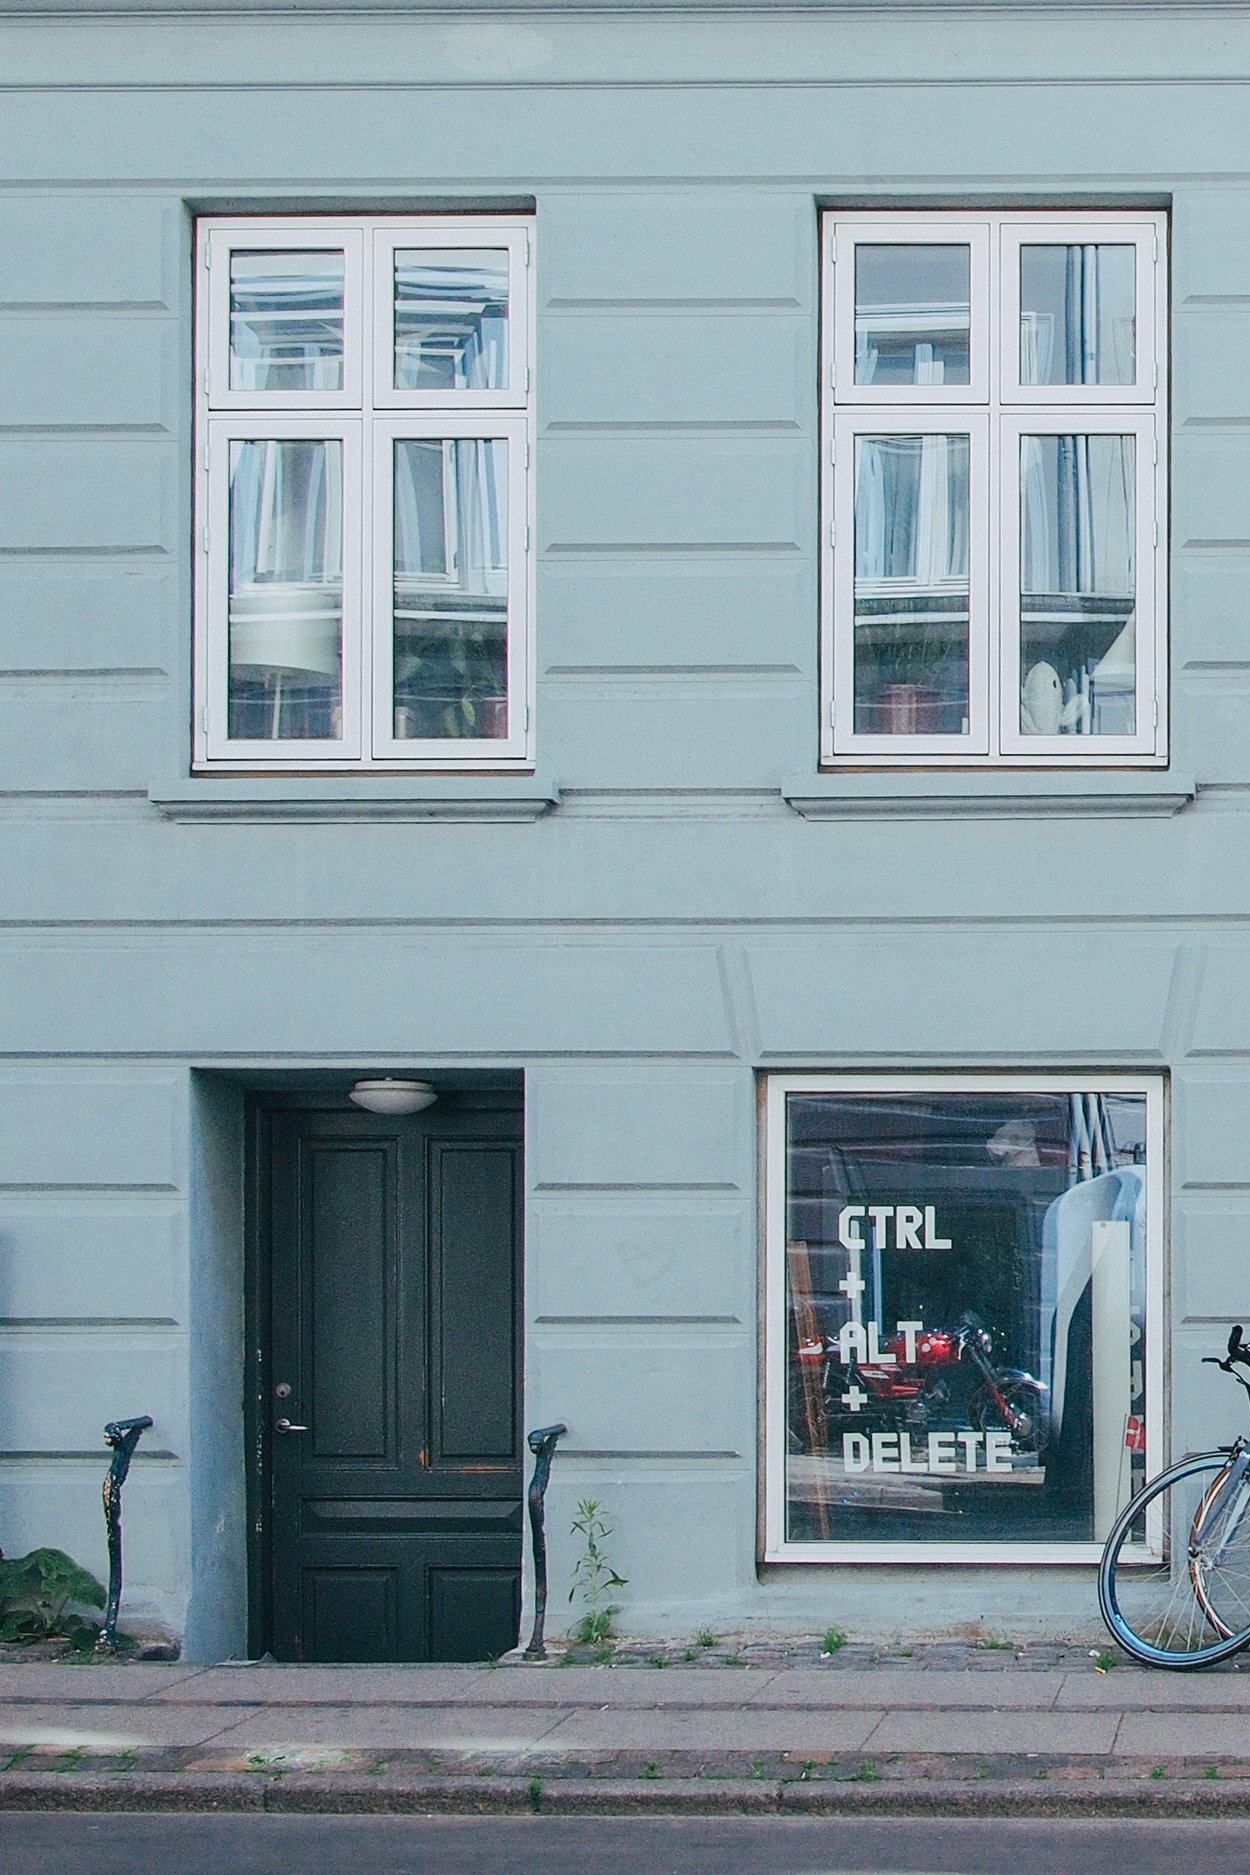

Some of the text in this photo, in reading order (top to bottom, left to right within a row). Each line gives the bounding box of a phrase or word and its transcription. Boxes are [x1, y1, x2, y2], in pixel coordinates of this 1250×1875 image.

[839, 1206, 952, 1249] CTRL
[839, 1272, 866, 1298] +
[839, 1321, 923, 1364] ALT
[842, 1386, 868, 1411] +
[843, 1432, 1013, 1473] DELETE
